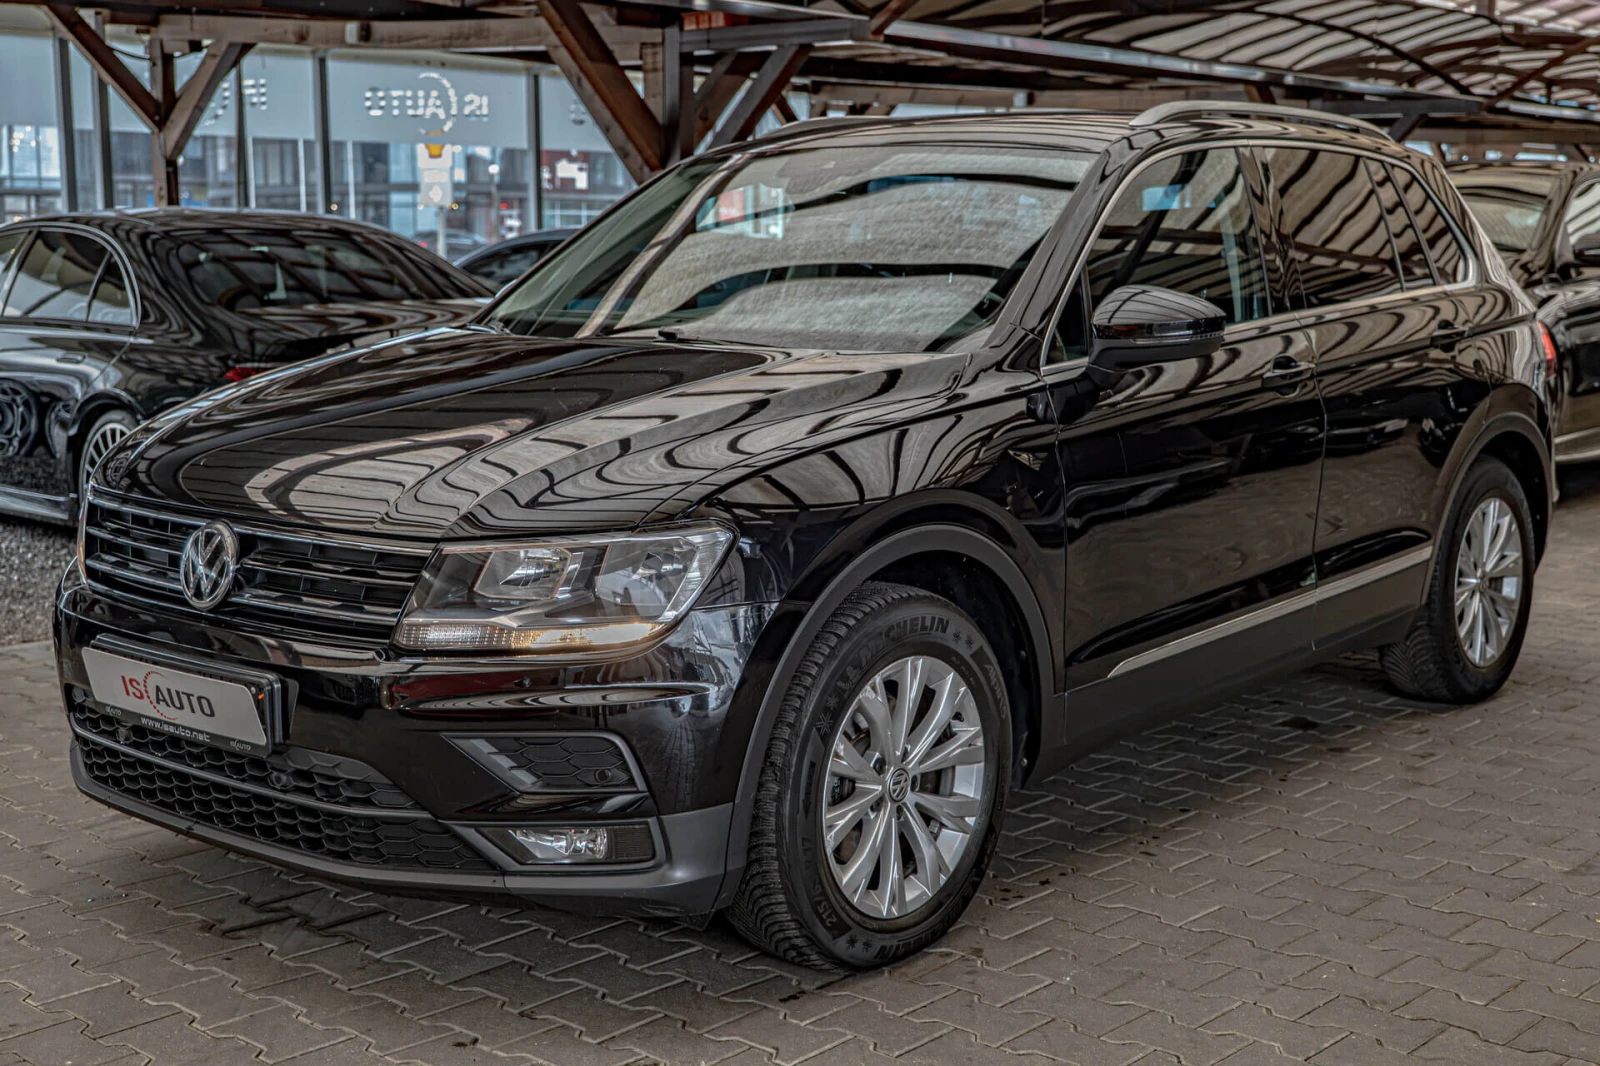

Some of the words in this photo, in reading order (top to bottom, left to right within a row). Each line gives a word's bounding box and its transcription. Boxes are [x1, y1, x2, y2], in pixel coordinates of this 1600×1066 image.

[860, 615, 950, 668] MICHELIN
[121, 674, 145, 700] IS
[155, 684, 216, 718] AUTO
[140, 716, 211, 742] www.isauto.net
